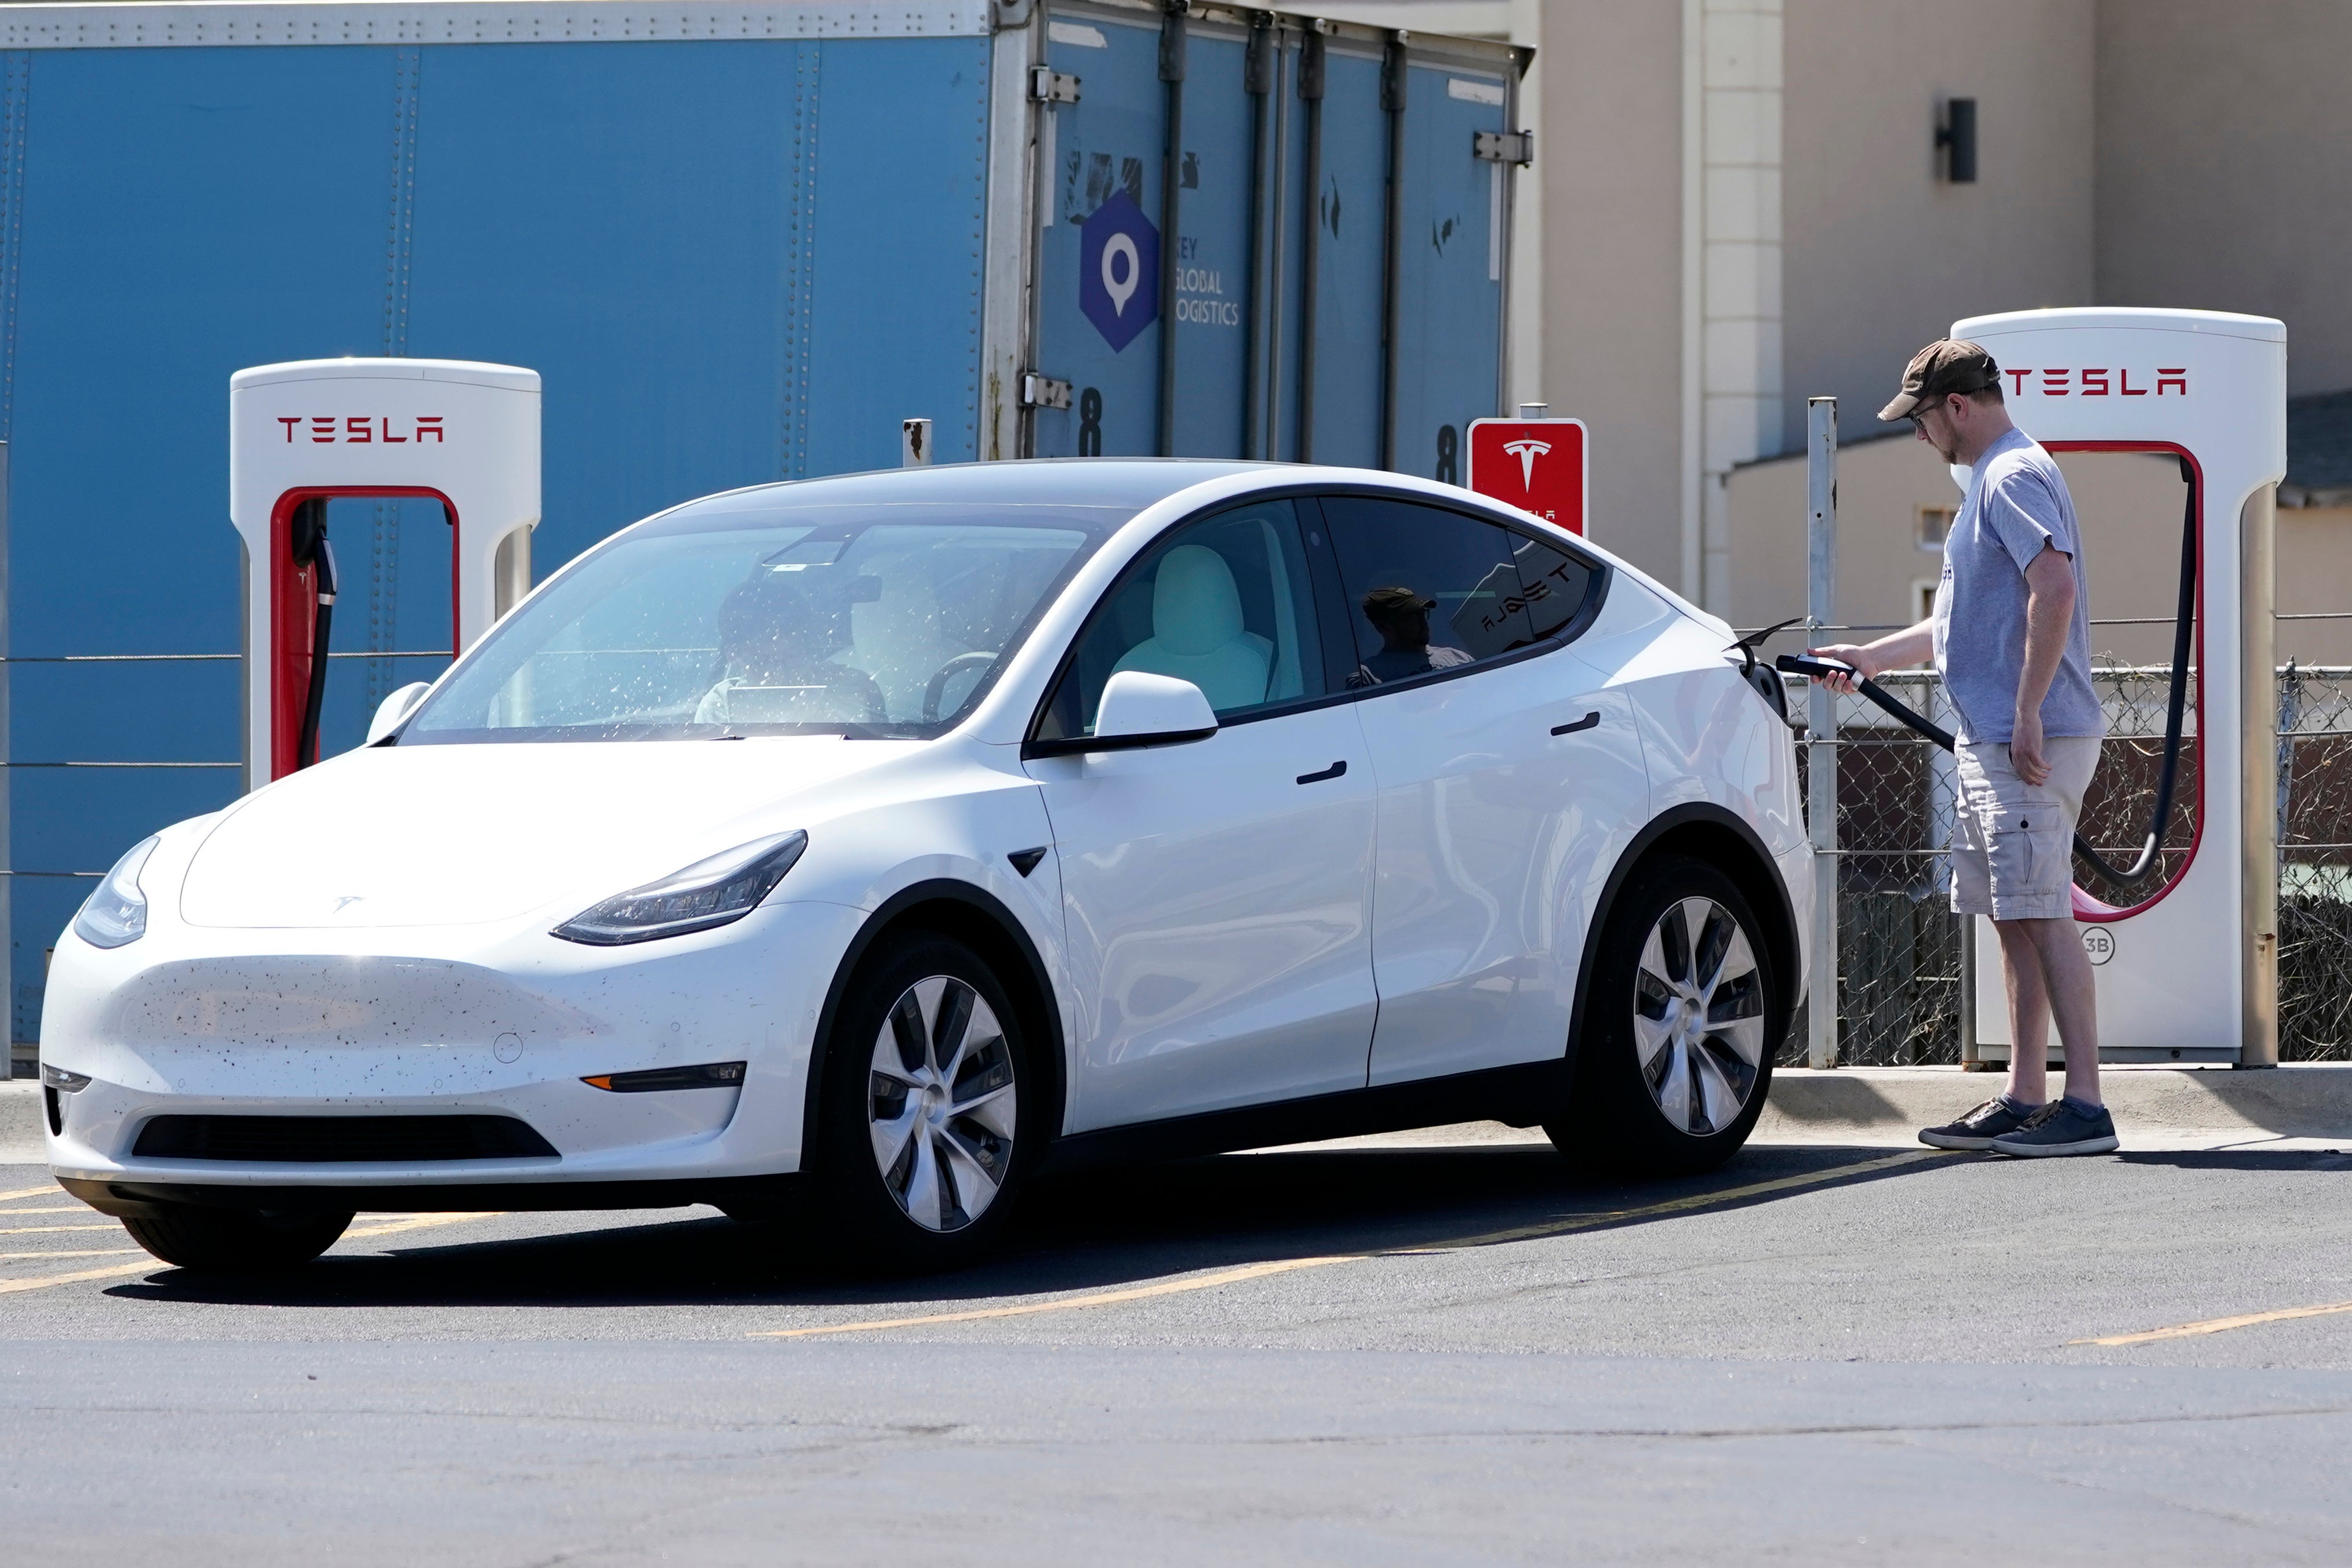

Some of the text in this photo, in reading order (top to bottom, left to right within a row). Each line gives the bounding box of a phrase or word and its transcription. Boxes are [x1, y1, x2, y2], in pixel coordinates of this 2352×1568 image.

[1177, 237, 1197, 260] EY
[1176, 298, 1238, 326] OGISTICS
[2005, 369, 2186, 396] TESLA
[277, 417, 444, 443] TESLA
[2086, 938, 2109, 952] 3B
